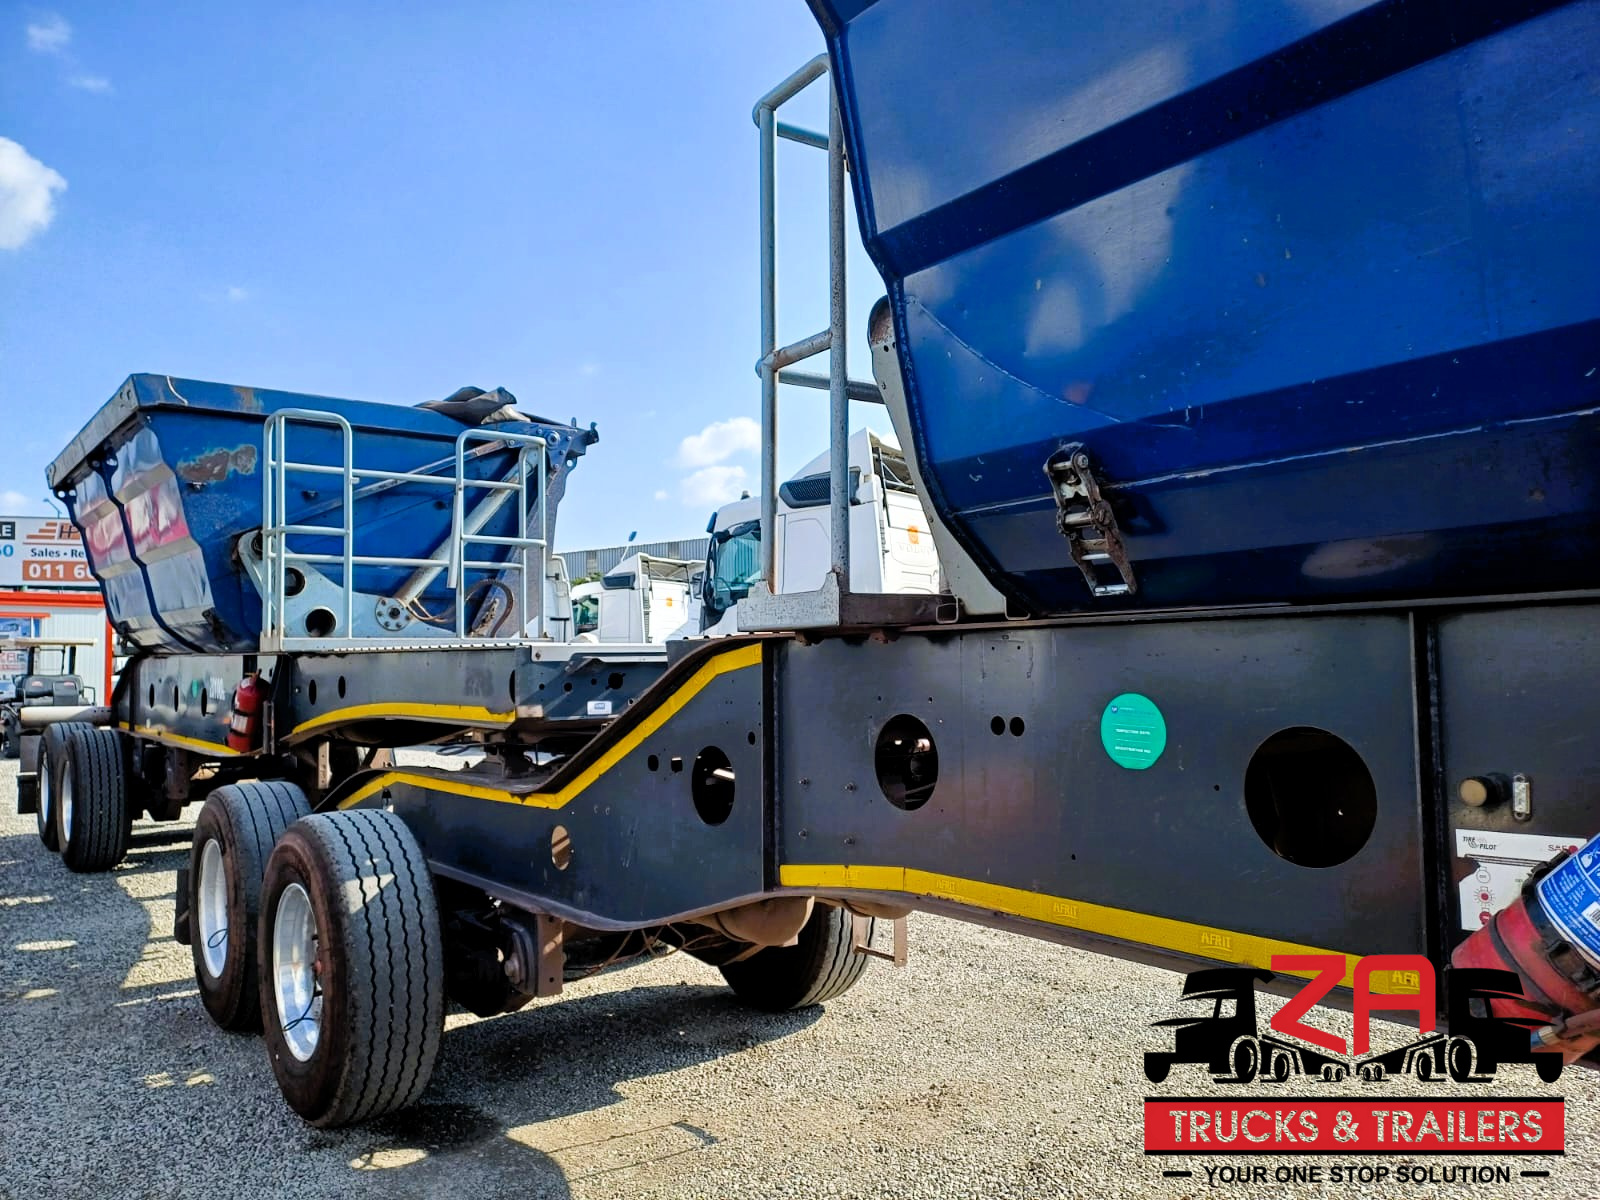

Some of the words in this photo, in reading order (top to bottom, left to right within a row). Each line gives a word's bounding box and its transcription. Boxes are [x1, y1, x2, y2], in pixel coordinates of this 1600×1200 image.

[0, 524, 13, 538] E
[30, 548, 61, 558] Sales
[28, 563, 65, 579] 011
[1479, 843, 1497, 851] PILOT
[1053, 902, 1079, 917] AFRIT
[1200, 931, 1232, 949] AFRIT
